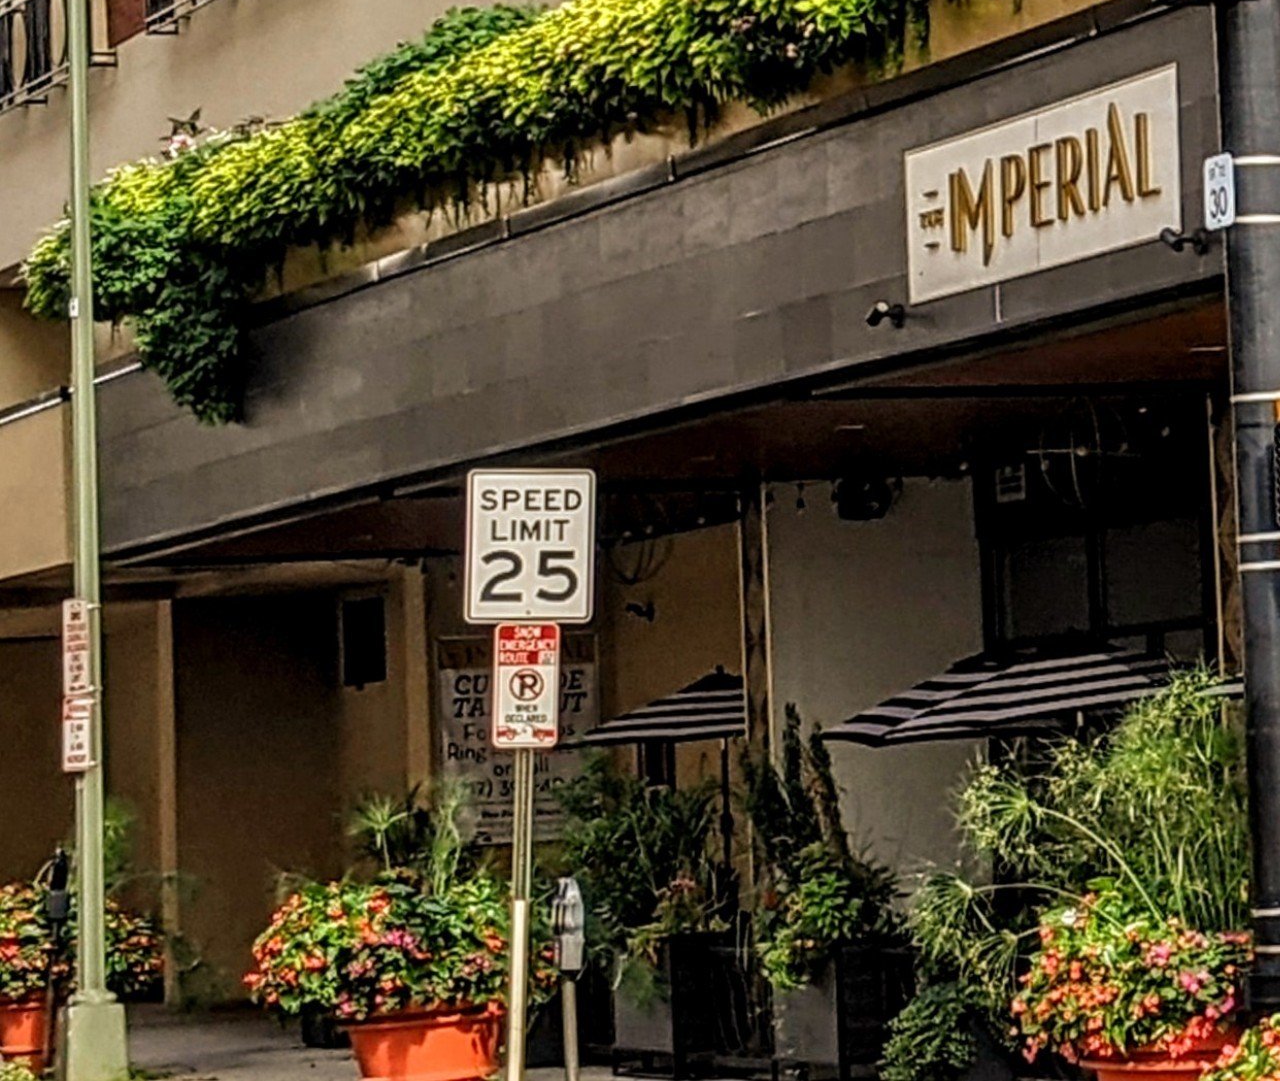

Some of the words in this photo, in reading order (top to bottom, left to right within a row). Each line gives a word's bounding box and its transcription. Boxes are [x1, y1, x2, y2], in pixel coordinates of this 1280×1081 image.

[949, 102, 1162, 267] IMPERIAL
[480, 489, 582, 511] SPEED
[490, 520, 570, 541] LIMIT
[480, 550, 578, 602] 25
[514, 625, 541, 639] SNOW
[500, 639, 556, 651] EMERGENCY
[505, 714, 547, 724] DECLARED
